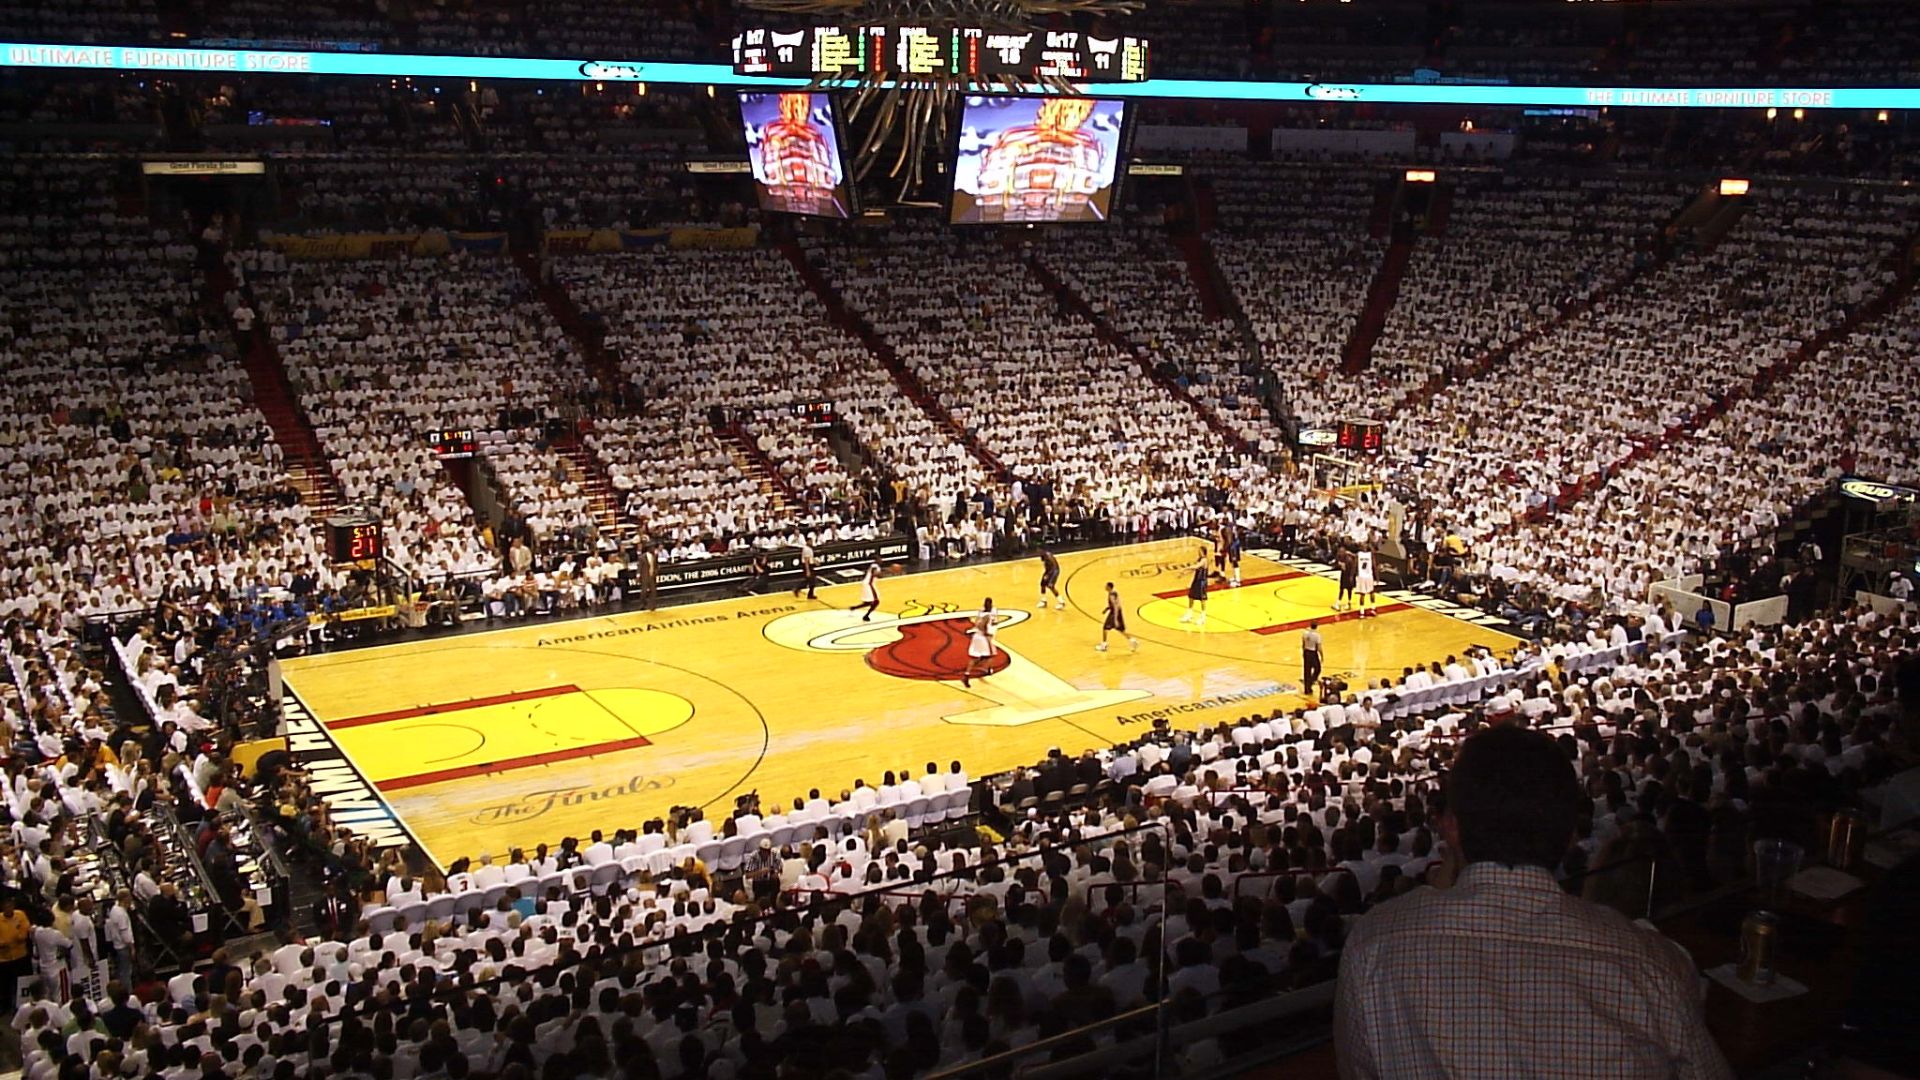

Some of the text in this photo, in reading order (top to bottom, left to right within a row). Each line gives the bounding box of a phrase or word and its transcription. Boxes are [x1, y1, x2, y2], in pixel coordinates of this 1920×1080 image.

[11, 48, 310, 70] ULTIMATE FURNITURE STORE
[777, 46, 793, 62] 11
[1095, 53, 1110, 69] 11
[1588, 91, 1832, 106] THE ULTIMATE FURNITURE STORE
[353, 525, 377, 539] 5:17
[352, 538, 373, 558] 21
[684, 571, 699, 580] THE
[701, 569, 719, 578] 2006
[537, 604, 797, 647] AmericanAirlines Arena
[1116, 683, 1297, 726] AmericanAirlines
[521, 776, 676, 815] Finals
